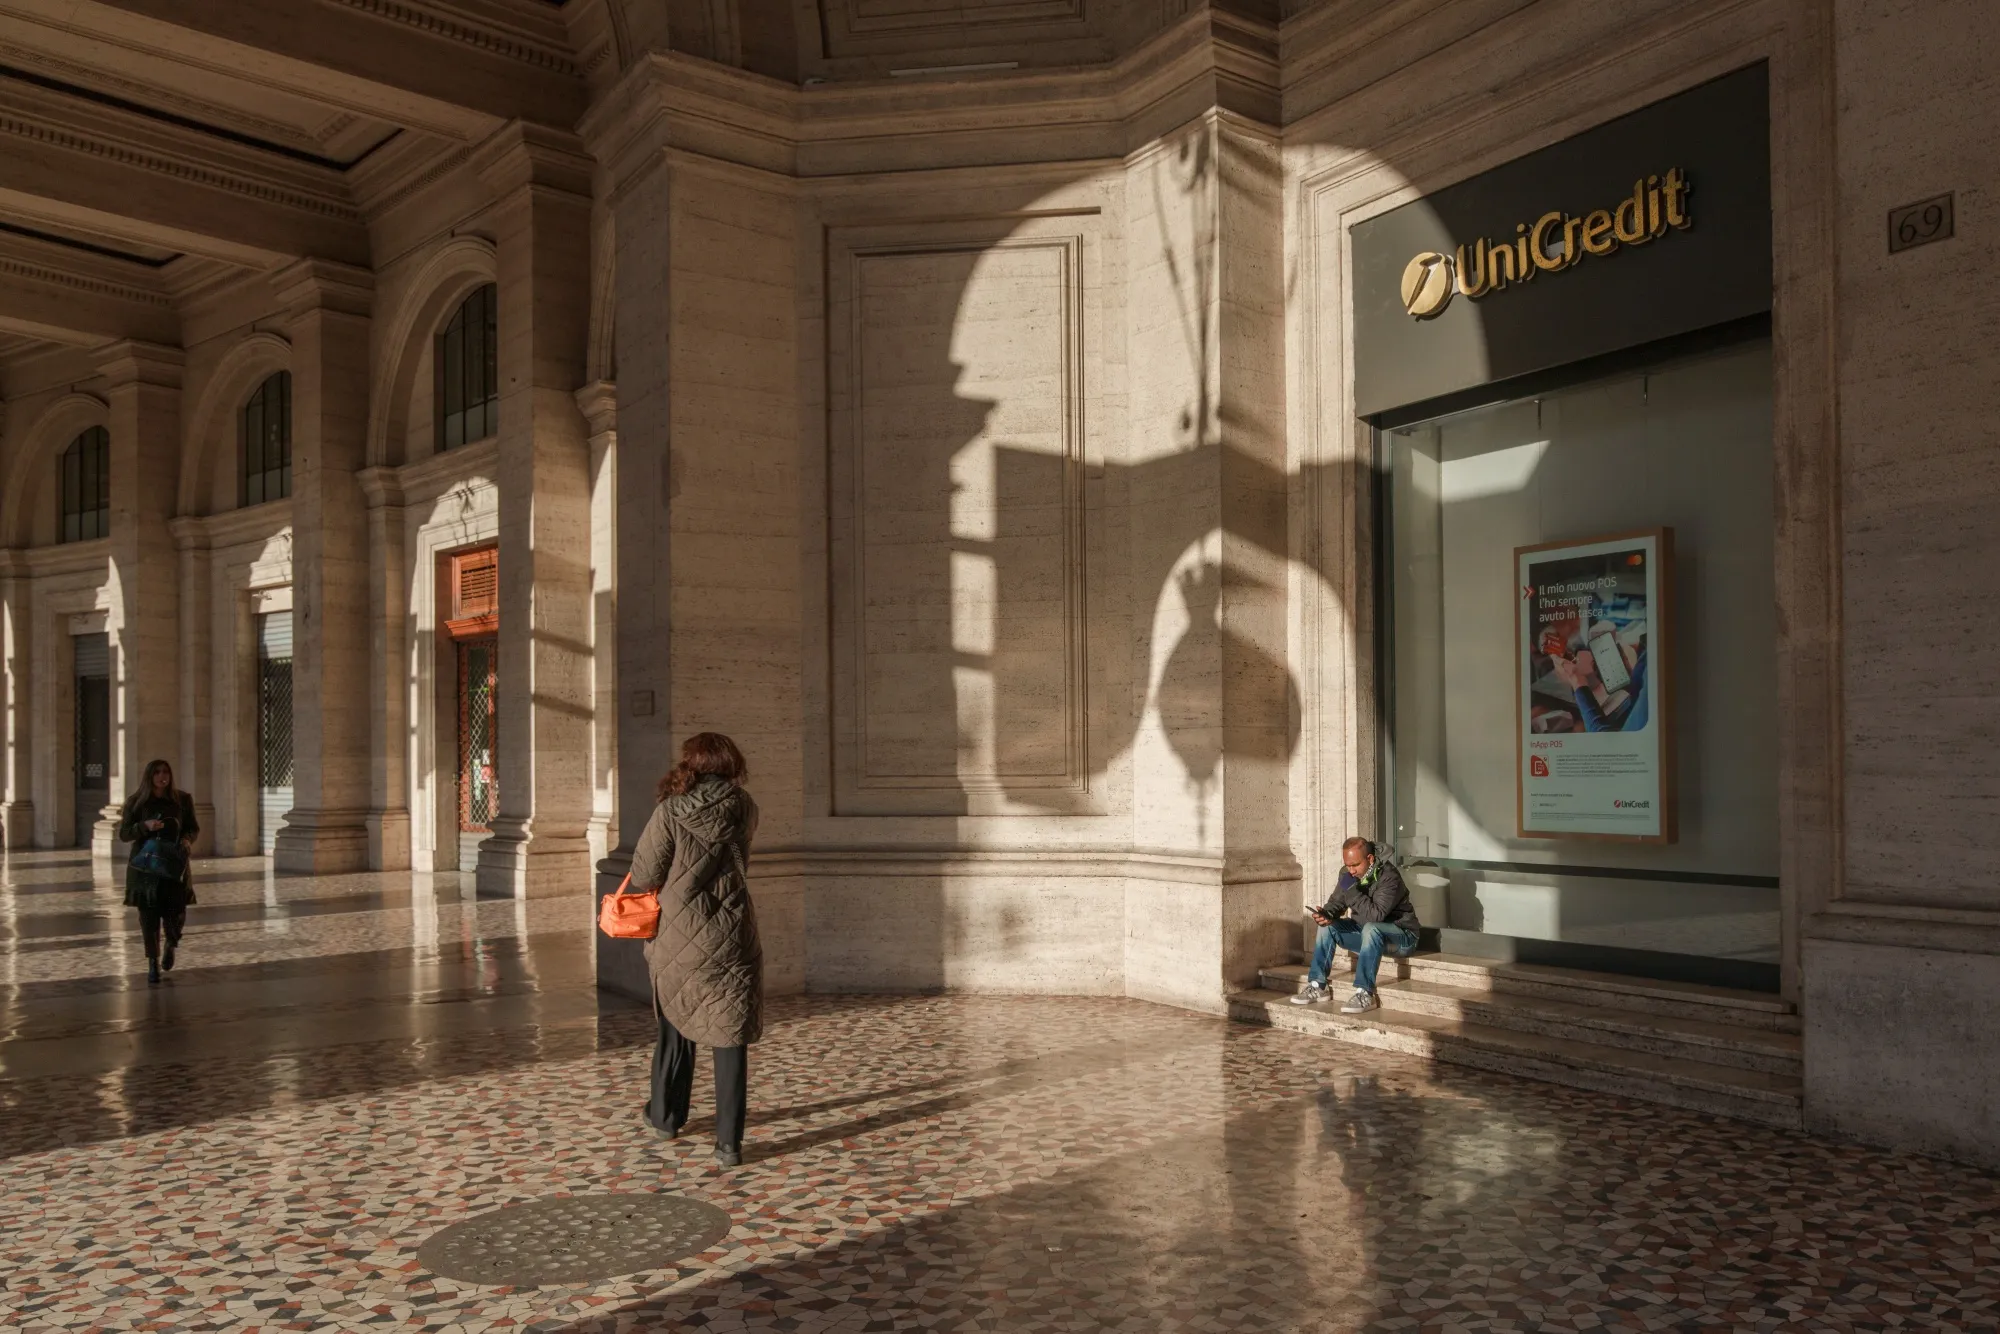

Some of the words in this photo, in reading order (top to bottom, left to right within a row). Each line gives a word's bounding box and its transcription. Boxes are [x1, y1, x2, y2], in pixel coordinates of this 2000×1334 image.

[1899, 204, 1942, 243] 69
[1456, 166, 1691, 297] UniCredit
[1539, 585, 1545, 596] Il
[1548, 583, 1565, 594] mio
[1567, 580, 1595, 592] nuovo
[1597, 576, 1618, 588] POS
[1539, 598, 1556, 609] l'ho
[1558, 595, 1593, 608] sempre
[1539, 610, 1565, 622] avuto
[1567, 609, 1576, 619] in
[1578, 608, 1606, 619] tasca.
[1530, 740, 1548, 749] InApp
[1550, 740, 1563, 748] POS
[1621, 800, 1650, 809] UniCredit
